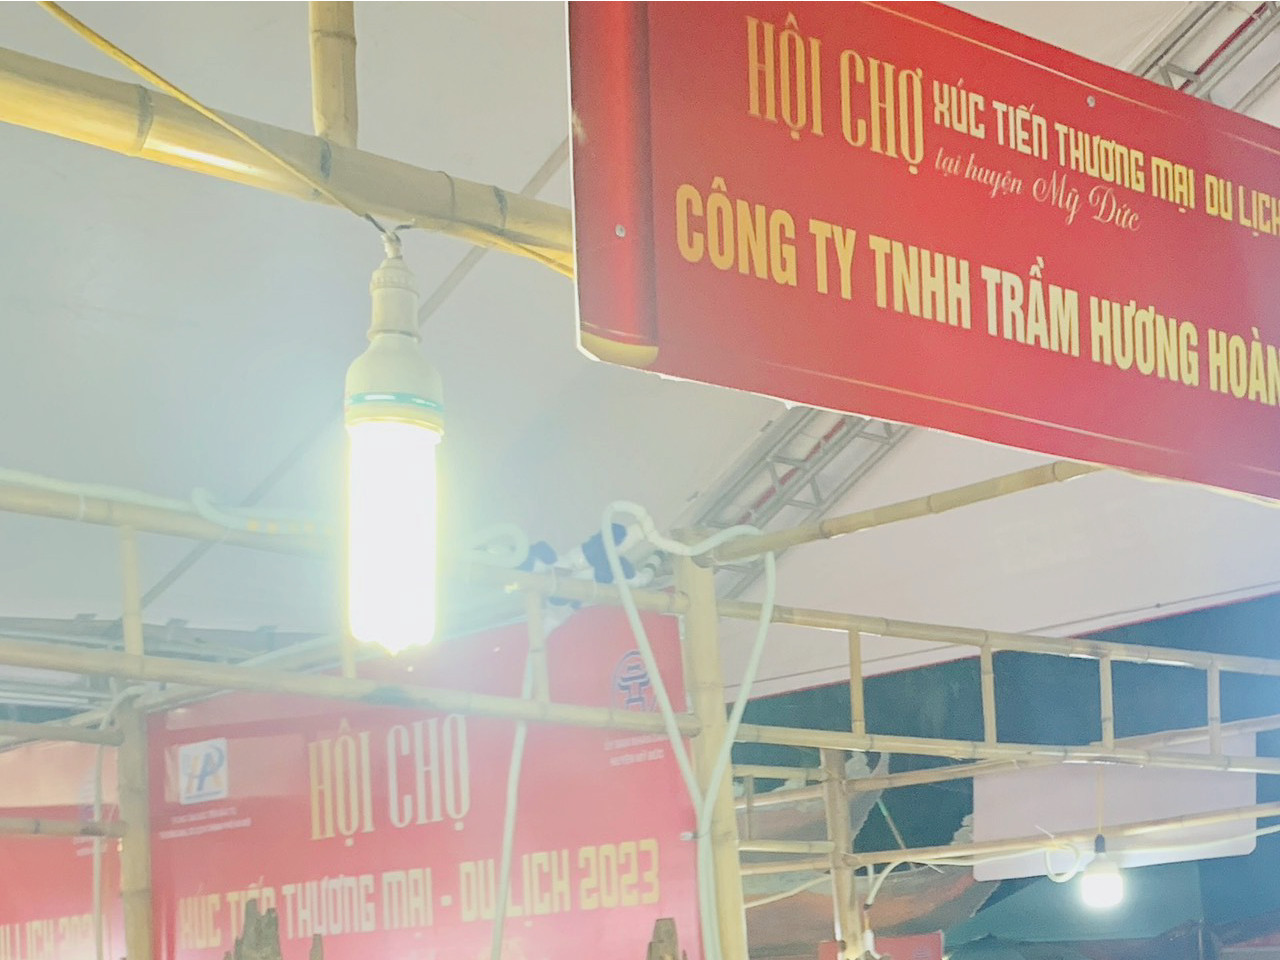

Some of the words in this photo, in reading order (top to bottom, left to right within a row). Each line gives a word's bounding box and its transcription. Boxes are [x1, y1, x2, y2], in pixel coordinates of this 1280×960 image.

[746, 11, 824, 140] HỘI
[840, 49, 924, 174] CHỢ
[933, 78, 986, 140] XÚC
[992, 102, 1048, 161] TIẾN
[1054, 121, 1145, 193] THƯƠNG
[1151, 156, 1196, 214] MẠI
[1205, 173, 1234, 221] DU
[935, 147, 961, 178] tại
[965, 152, 1023, 198] huyện
[1032, 170, 1081, 226] Mỹ
[1088, 184, 1142, 232] Đức
[675, 176, 798, 287] CÔNG
[808, 218, 857, 302] TY
[868, 234, 972, 330] TNHH
[980, 256, 1080, 358] TRẦM
[1088, 296, 1200, 387] HƯƠNG
[308, 719, 374, 846] HỘI
[386, 713, 471, 831] CHỢ
[281, 872, 376, 939] THƯƠNG
[382, 867, 433, 938] MẠI
[459, 858, 496, 922] DU
[578, 839, 660, 910] 2023
